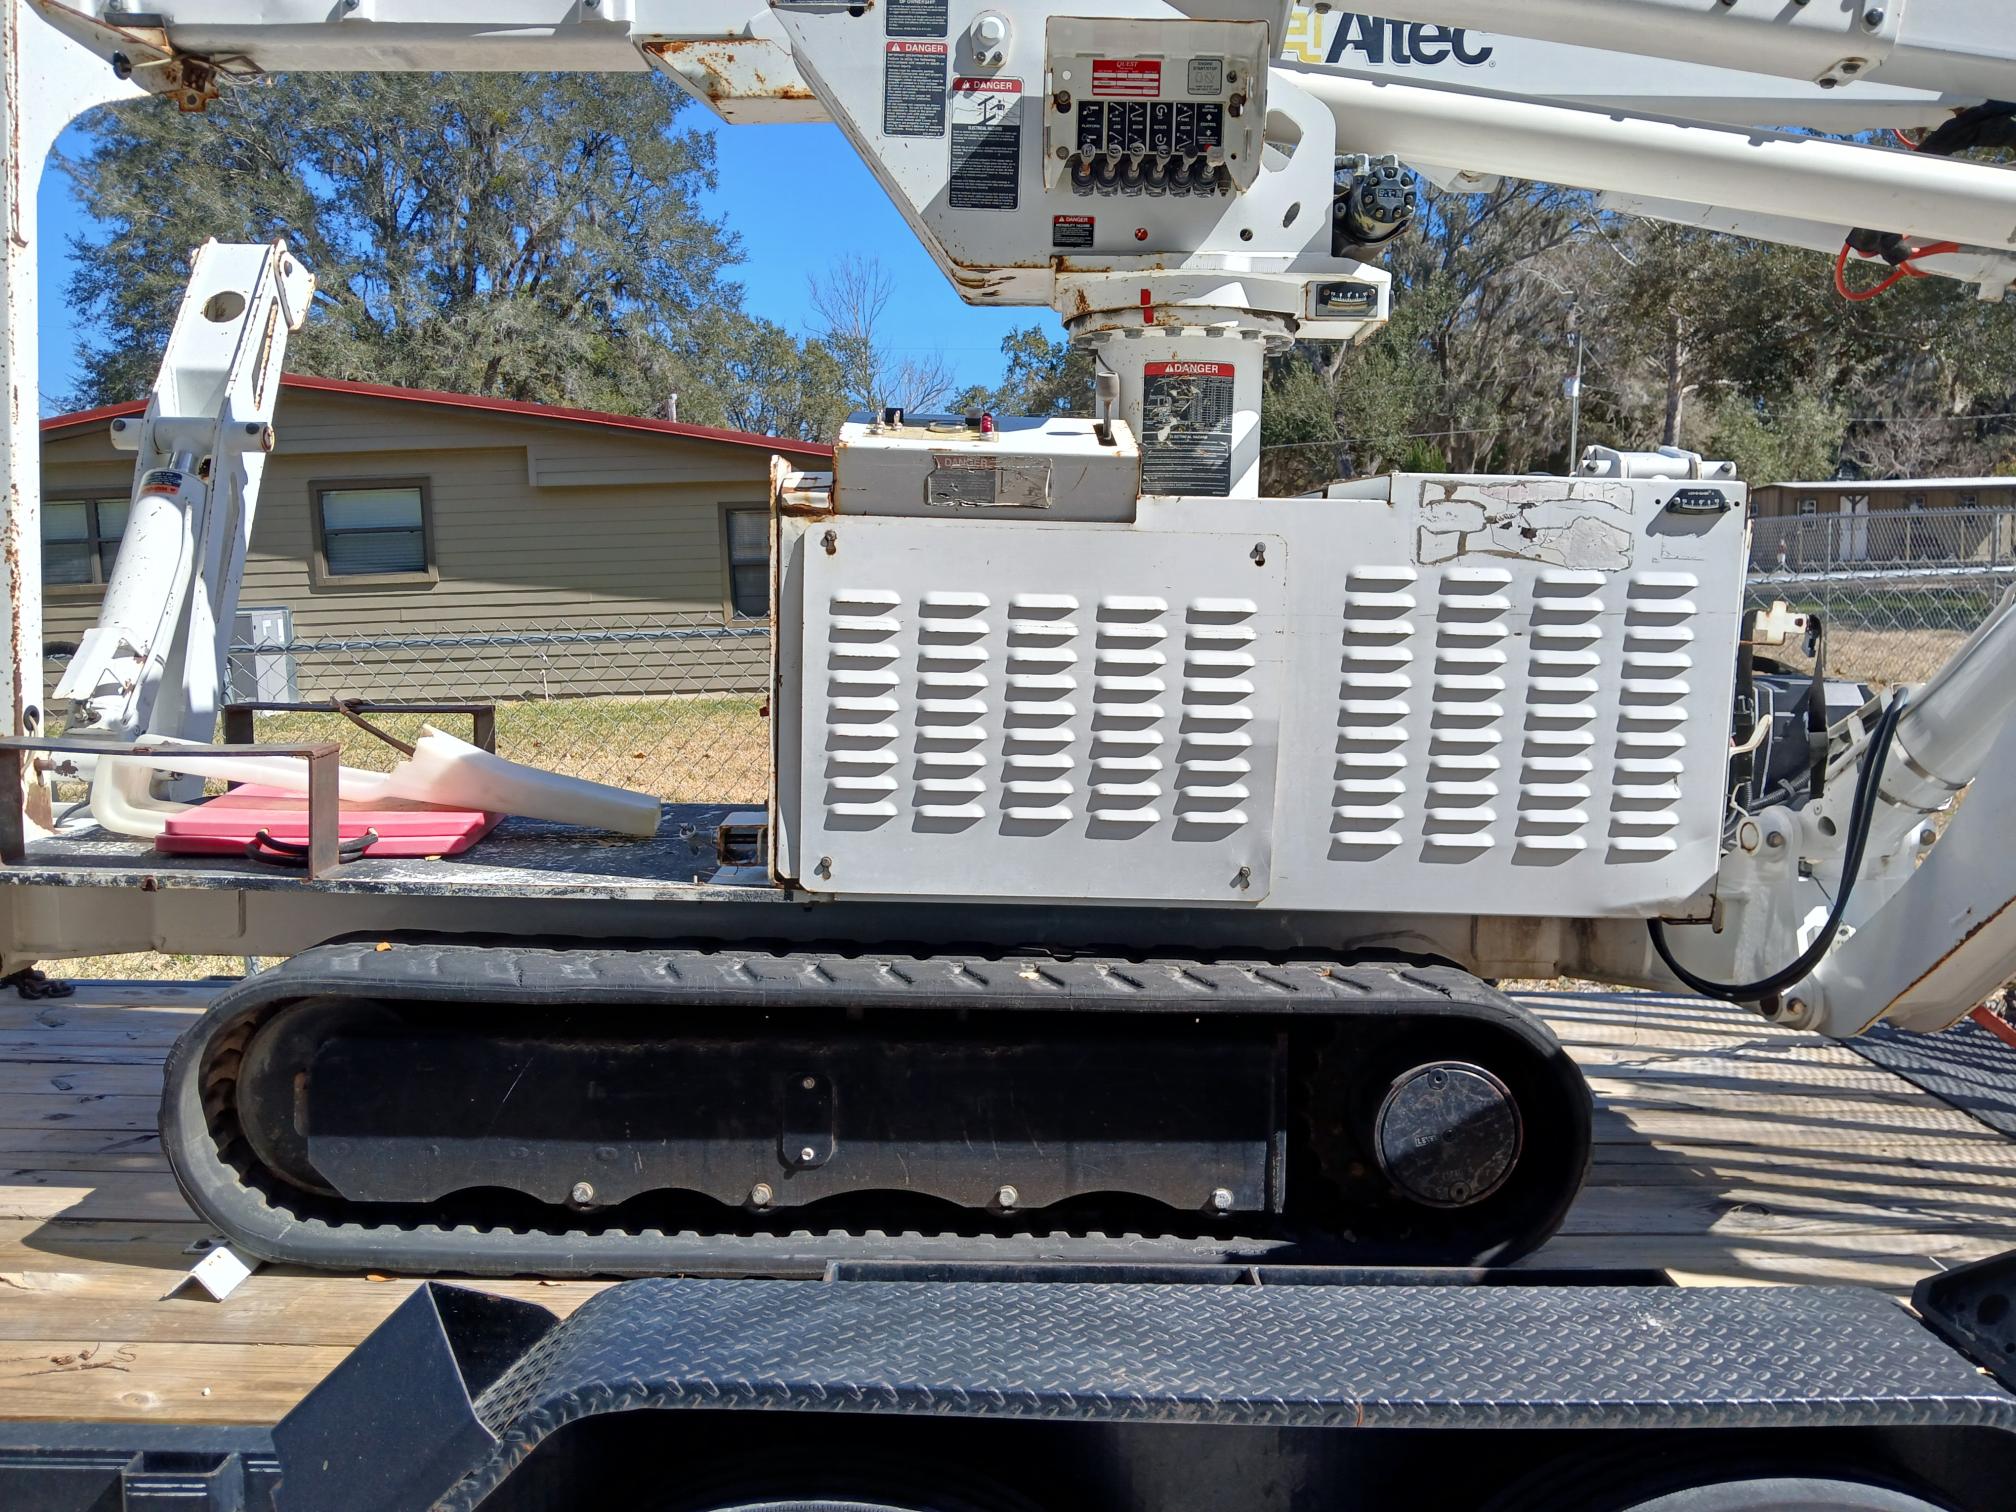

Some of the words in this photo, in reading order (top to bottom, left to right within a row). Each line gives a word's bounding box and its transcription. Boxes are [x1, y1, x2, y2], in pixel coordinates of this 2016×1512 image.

[1325, 12, 1493, 65] Altec
[905, 43, 944, 53] DANGER
[973, 80, 1013, 90] DANGER
[1174, 363, 1219, 374] DANGER
[944, 457, 988, 467] DANGER
